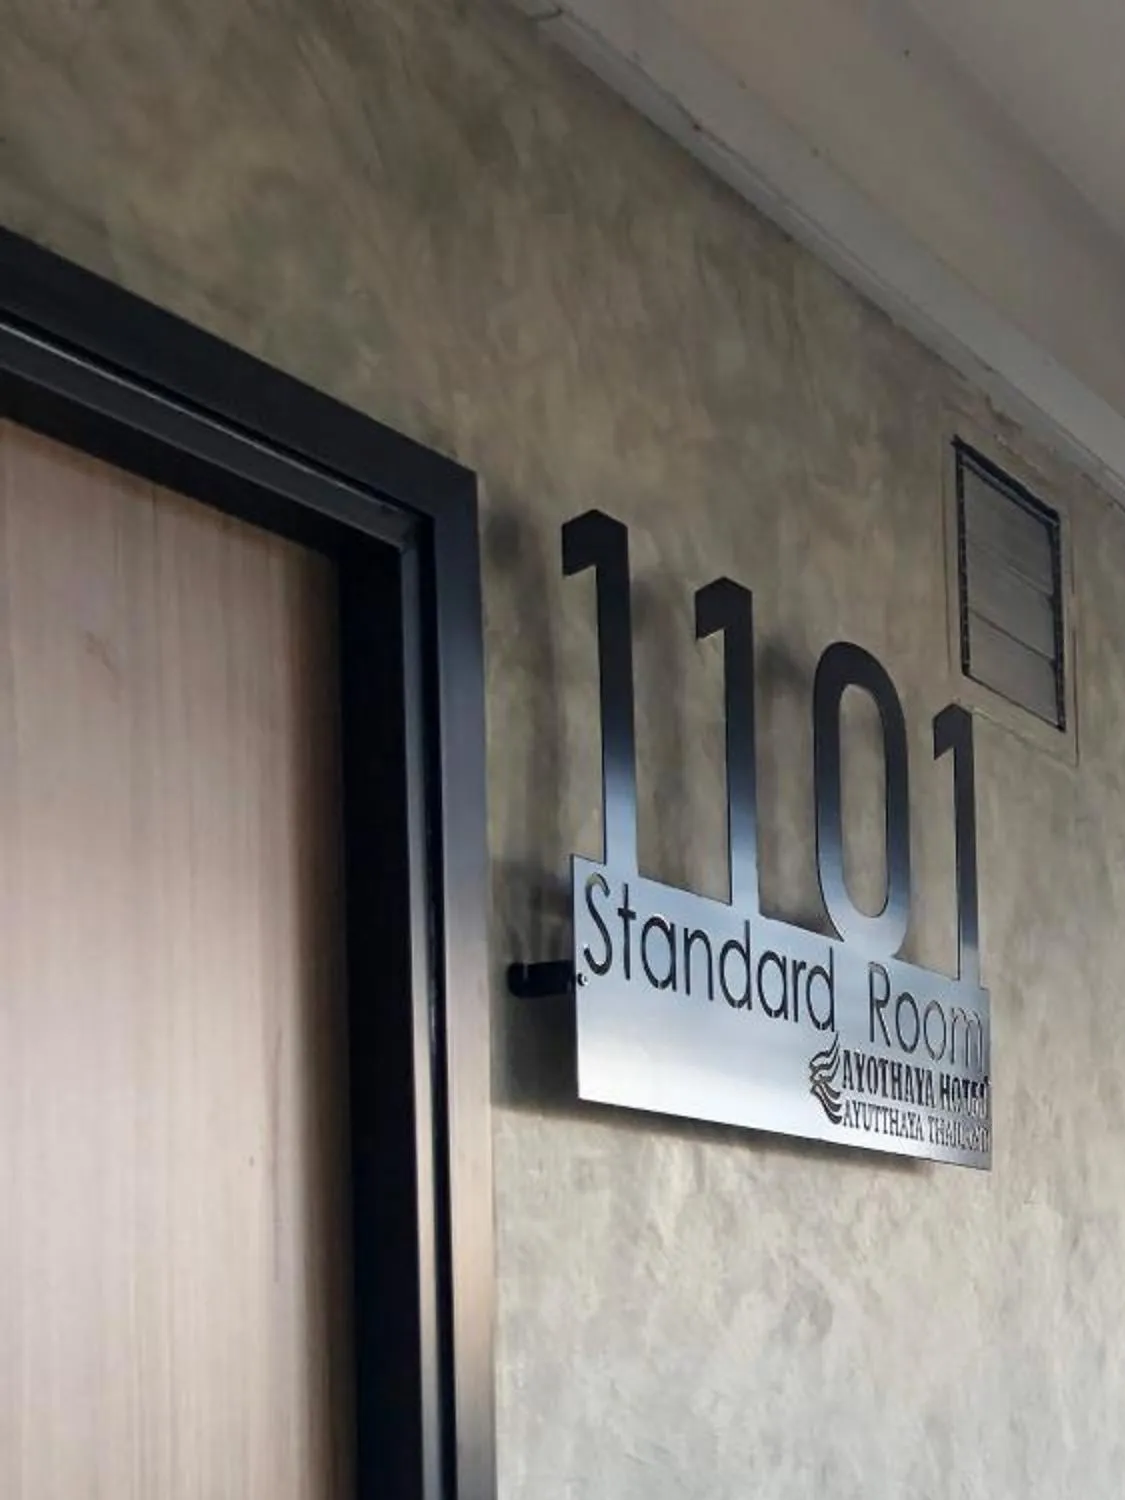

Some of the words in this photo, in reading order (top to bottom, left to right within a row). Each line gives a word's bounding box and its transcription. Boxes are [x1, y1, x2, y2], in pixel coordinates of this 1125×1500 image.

[562, 509, 980, 985] 1101
[583, 872, 835, 1032] Standard
[868, 961, 984, 1073] Room
[842, 1049, 935, 1108] AYOTHAYA
[843, 1099, 925, 1142] AYUTTHAYA
